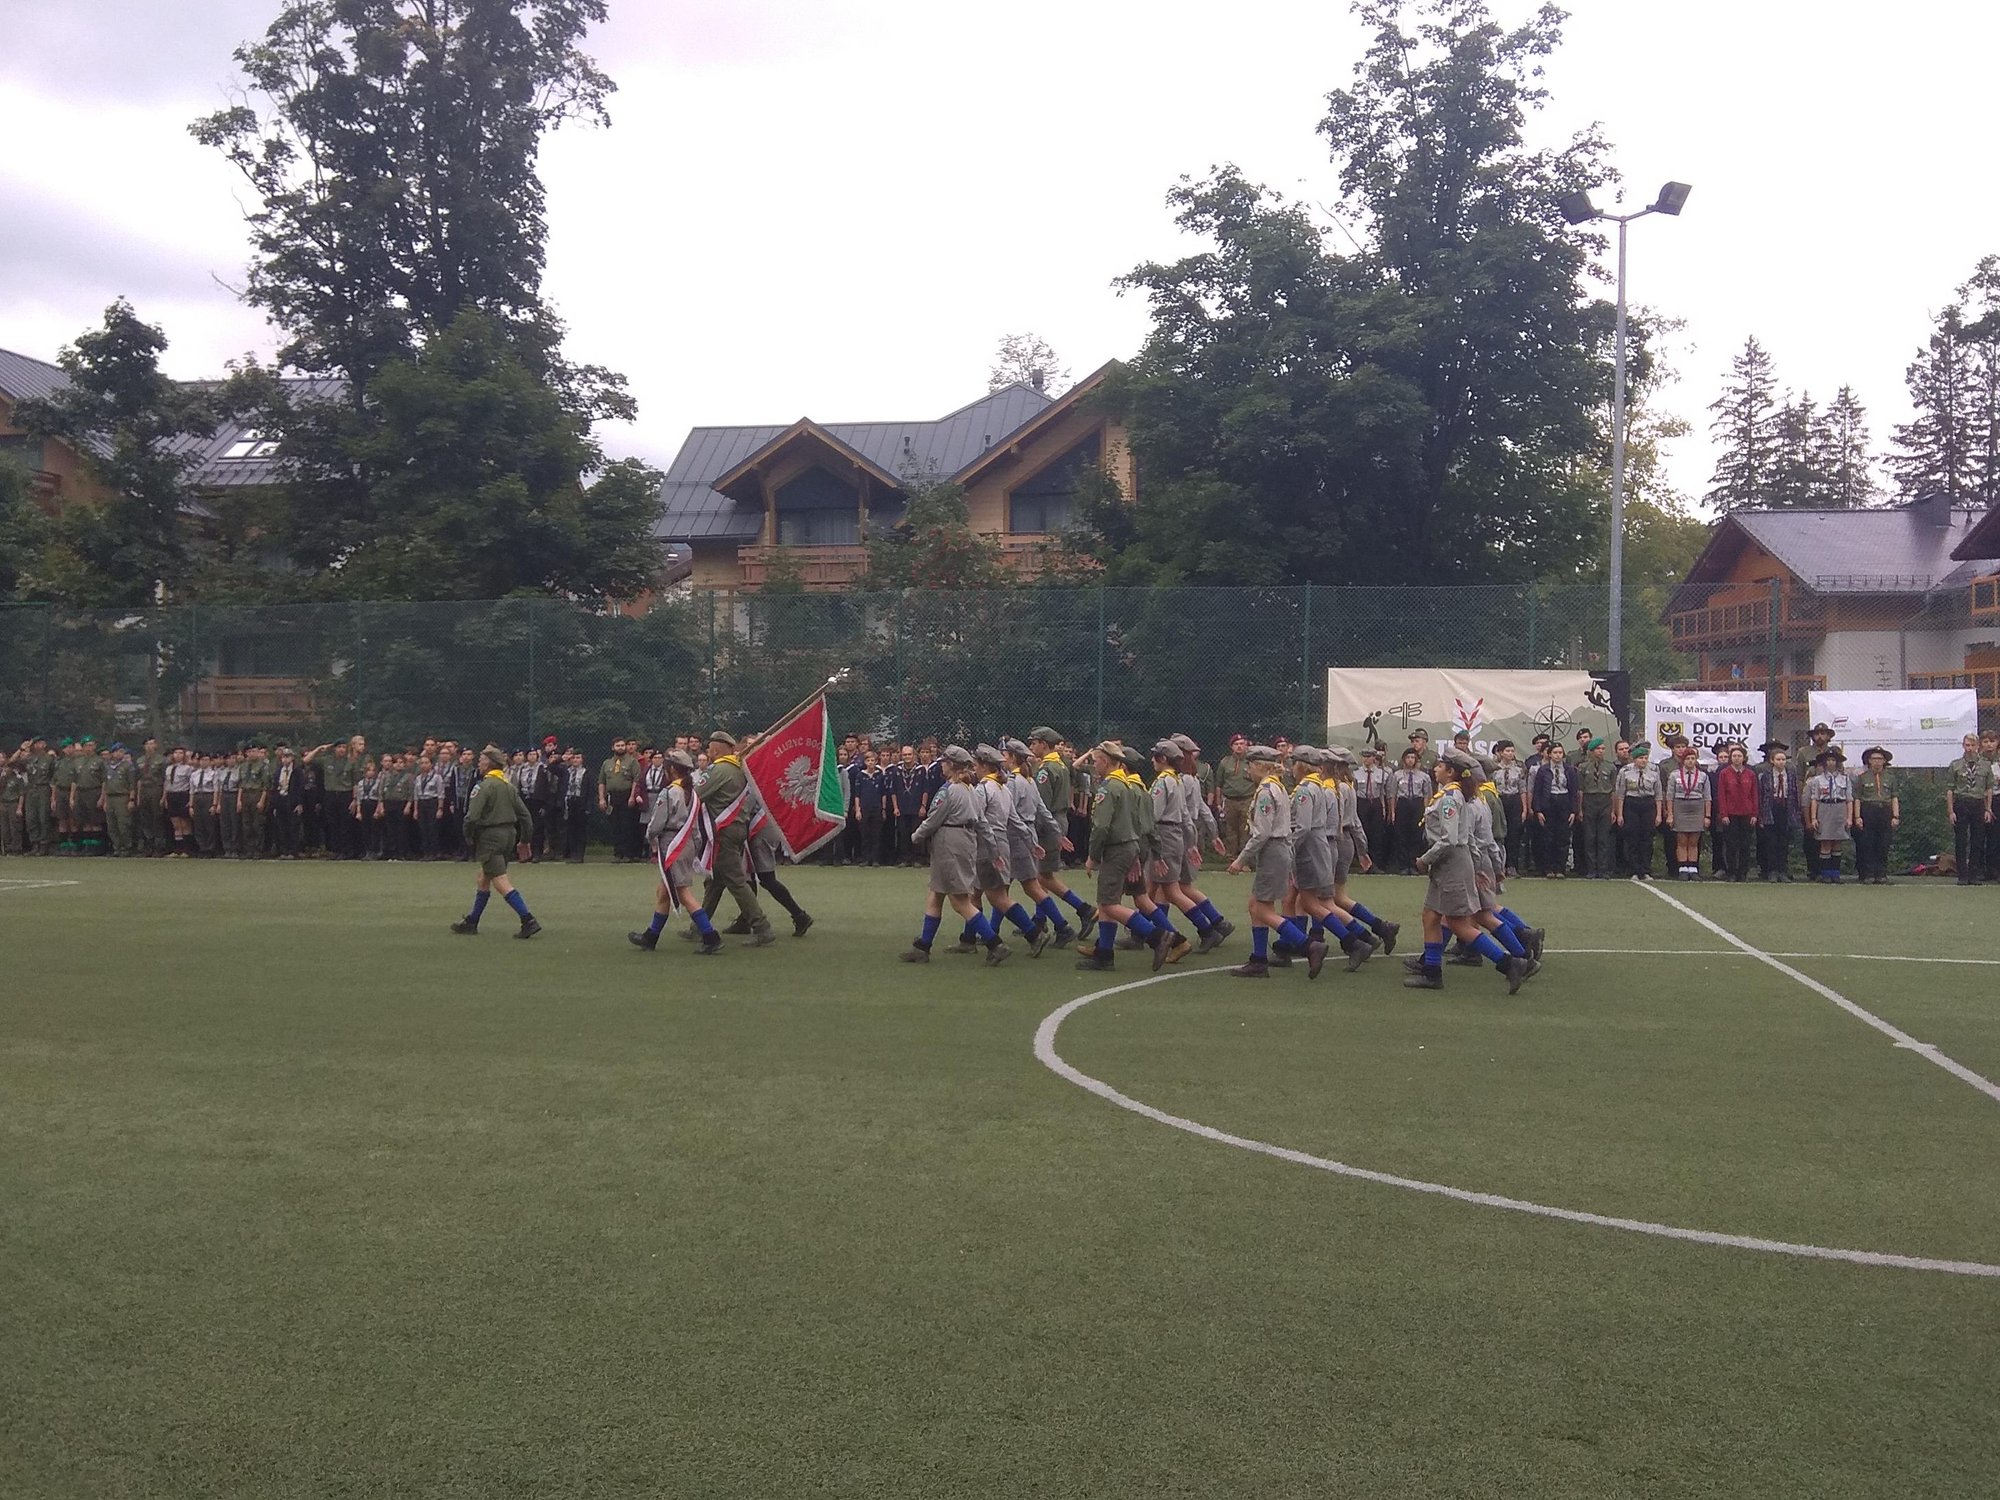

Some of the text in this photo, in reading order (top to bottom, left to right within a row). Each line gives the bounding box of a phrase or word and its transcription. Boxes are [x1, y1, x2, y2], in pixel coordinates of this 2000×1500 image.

[1655, 705, 1756, 715] Urząd Marszałkowski
[1693, 722, 1752, 735] DOLNY
